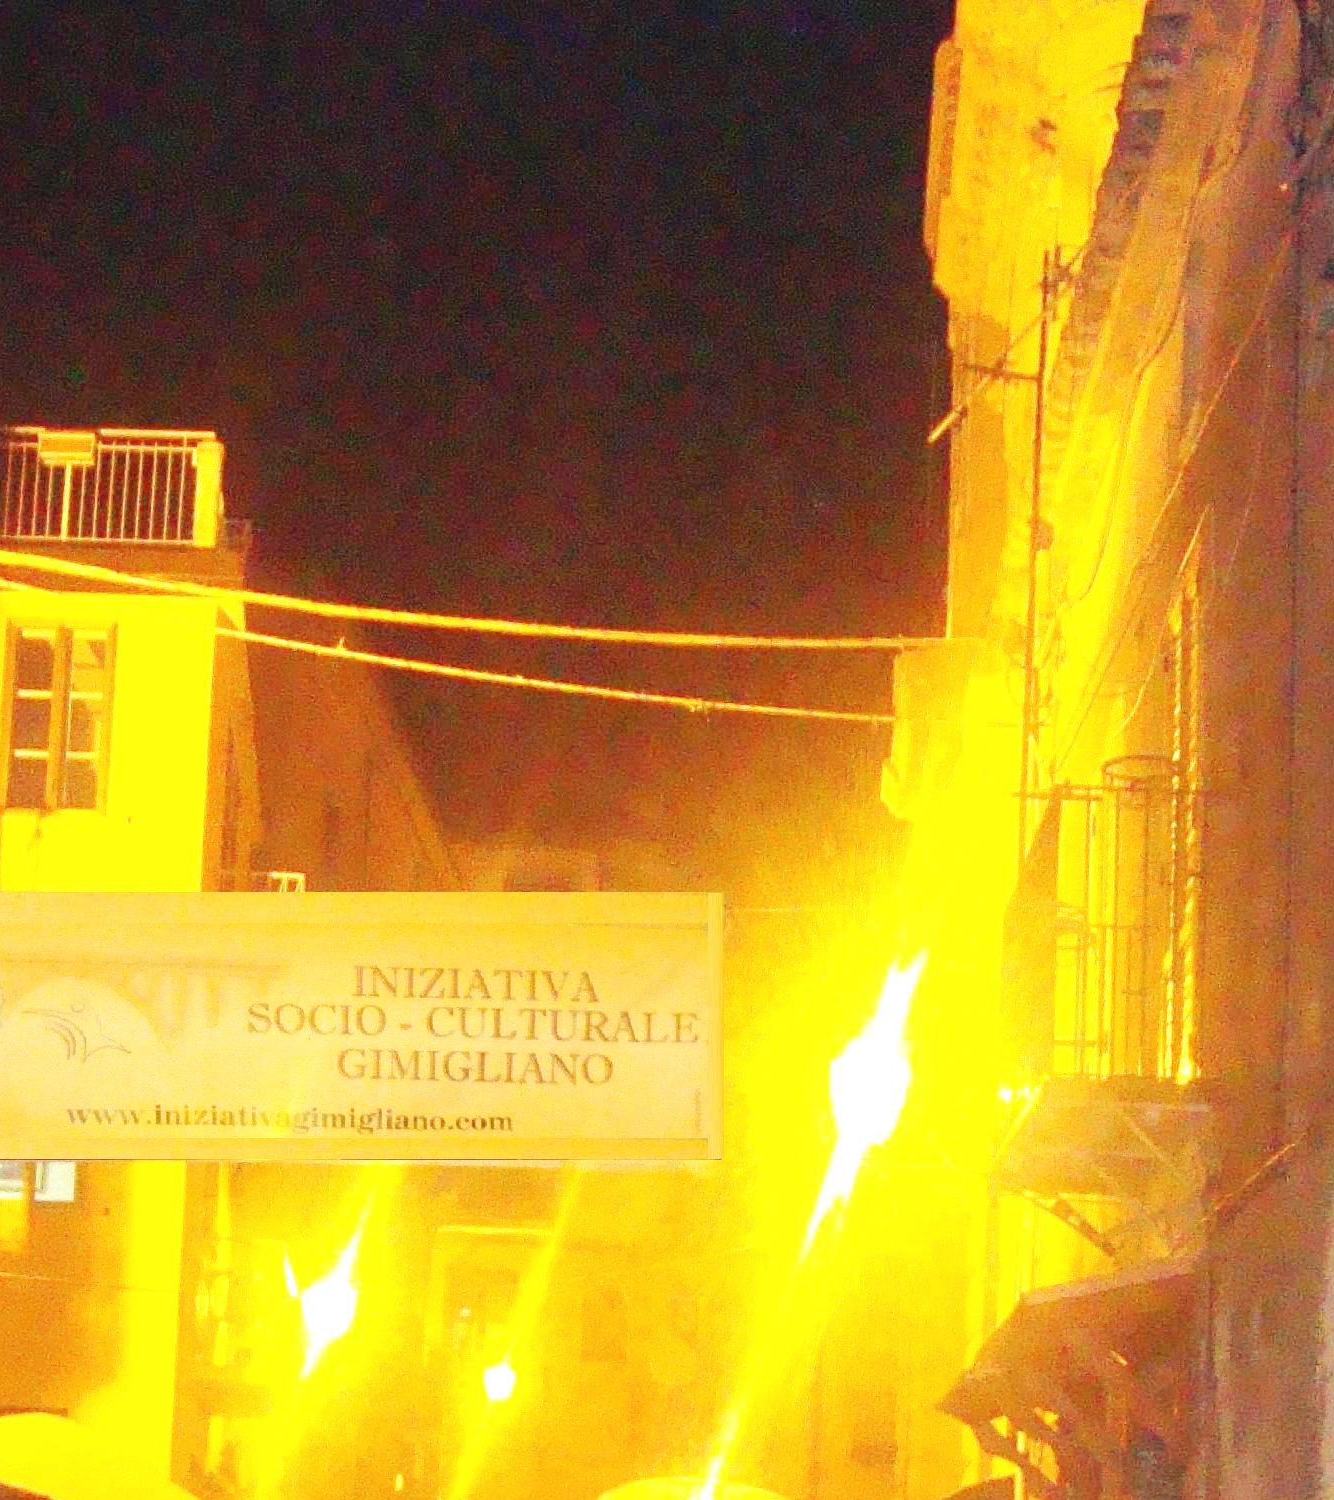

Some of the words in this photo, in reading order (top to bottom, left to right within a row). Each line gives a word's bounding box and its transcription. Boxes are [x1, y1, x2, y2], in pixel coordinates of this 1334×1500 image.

[353, 964, 599, 1003] INIZIATIVA
[246, 1003, 388, 1036] SOCIO
[425, 1005, 701, 1044] CULTURALE
[337, 1047, 614, 1086] GIMIGLIANO
[66, 1103, 515, 1135] www.iniziativagimigliano.com
